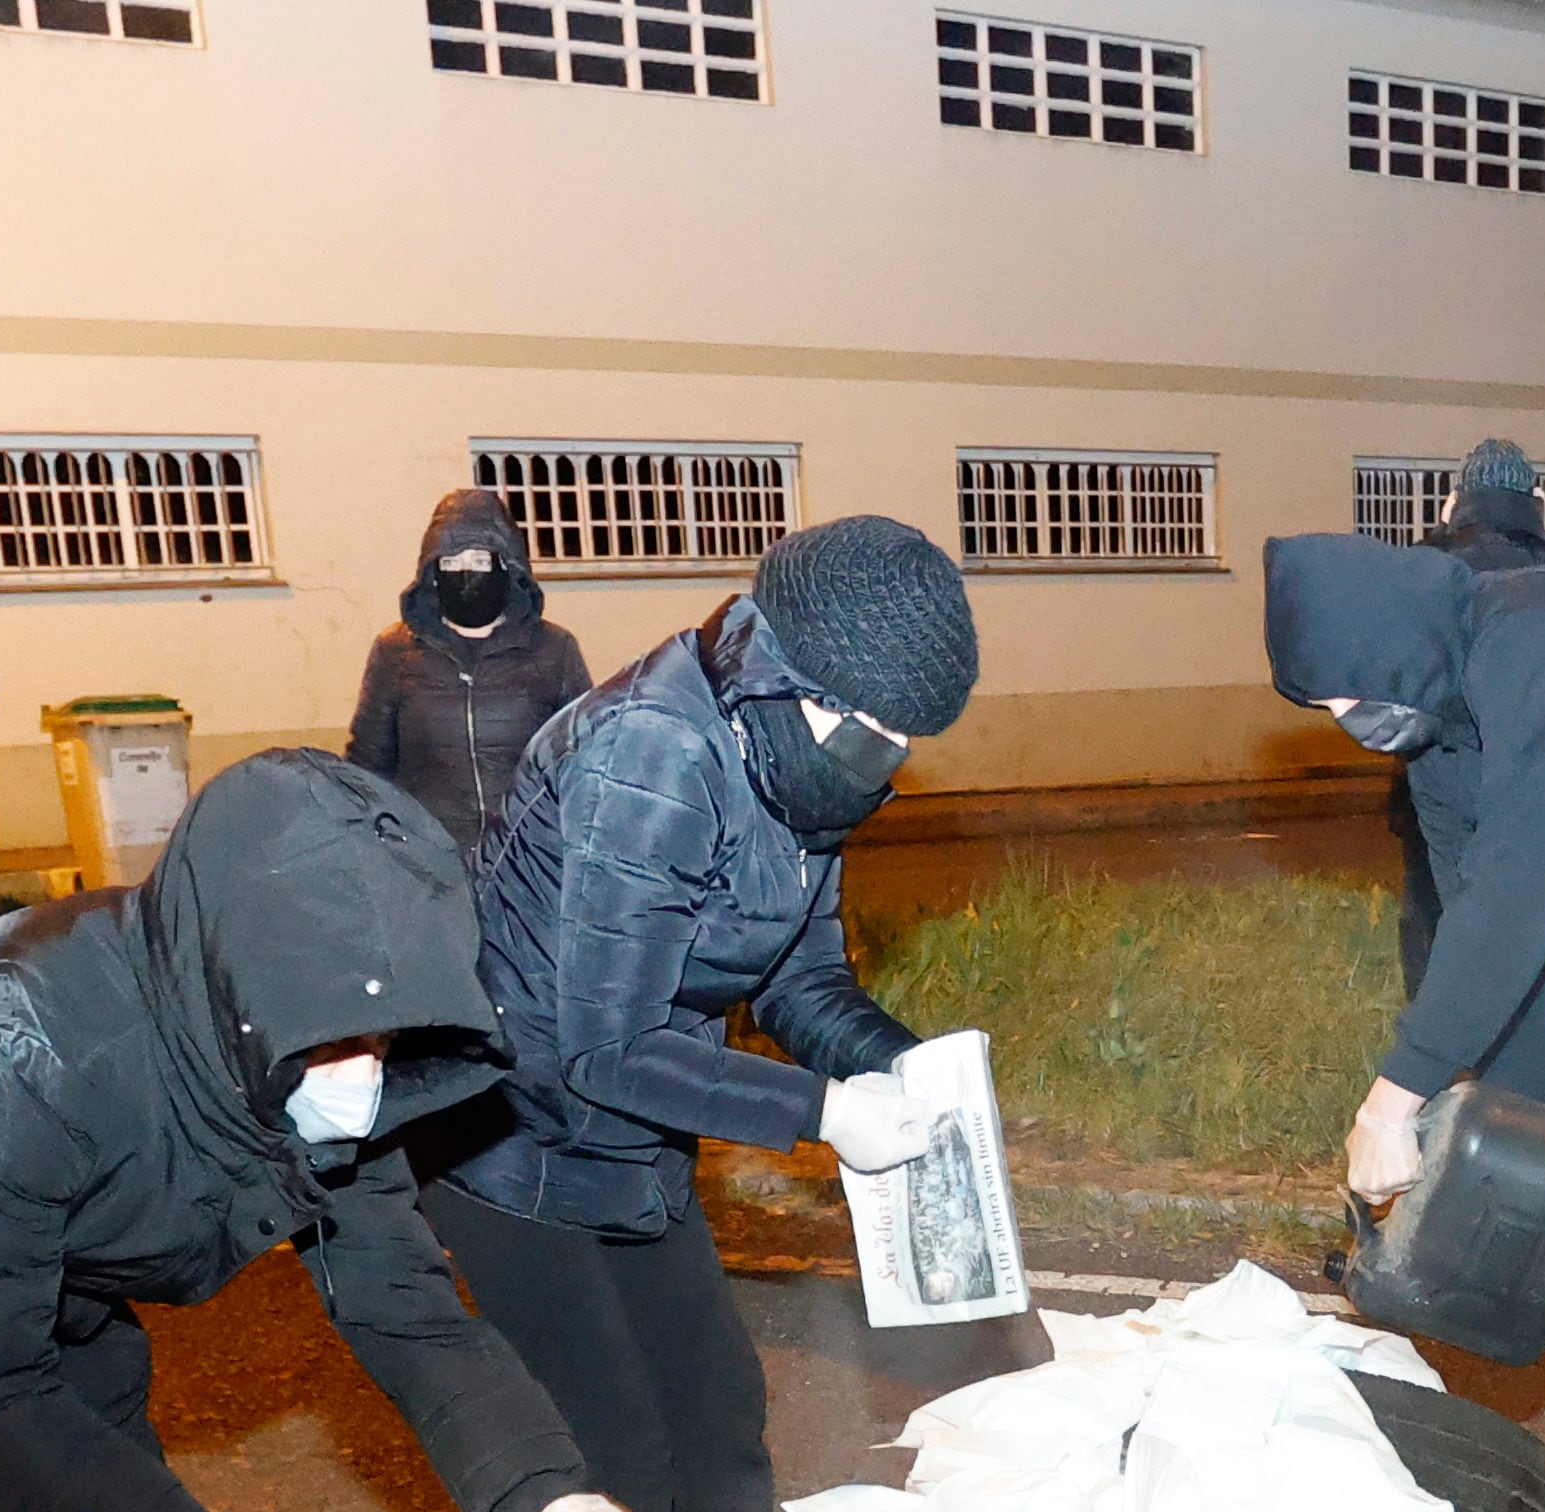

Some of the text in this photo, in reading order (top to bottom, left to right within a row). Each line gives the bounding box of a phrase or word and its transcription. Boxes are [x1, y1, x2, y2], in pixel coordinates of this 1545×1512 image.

[983, 1162, 998, 1190] sin
[998, 1246, 1013, 1272] UE
[1005, 1275, 1018, 1295] La
